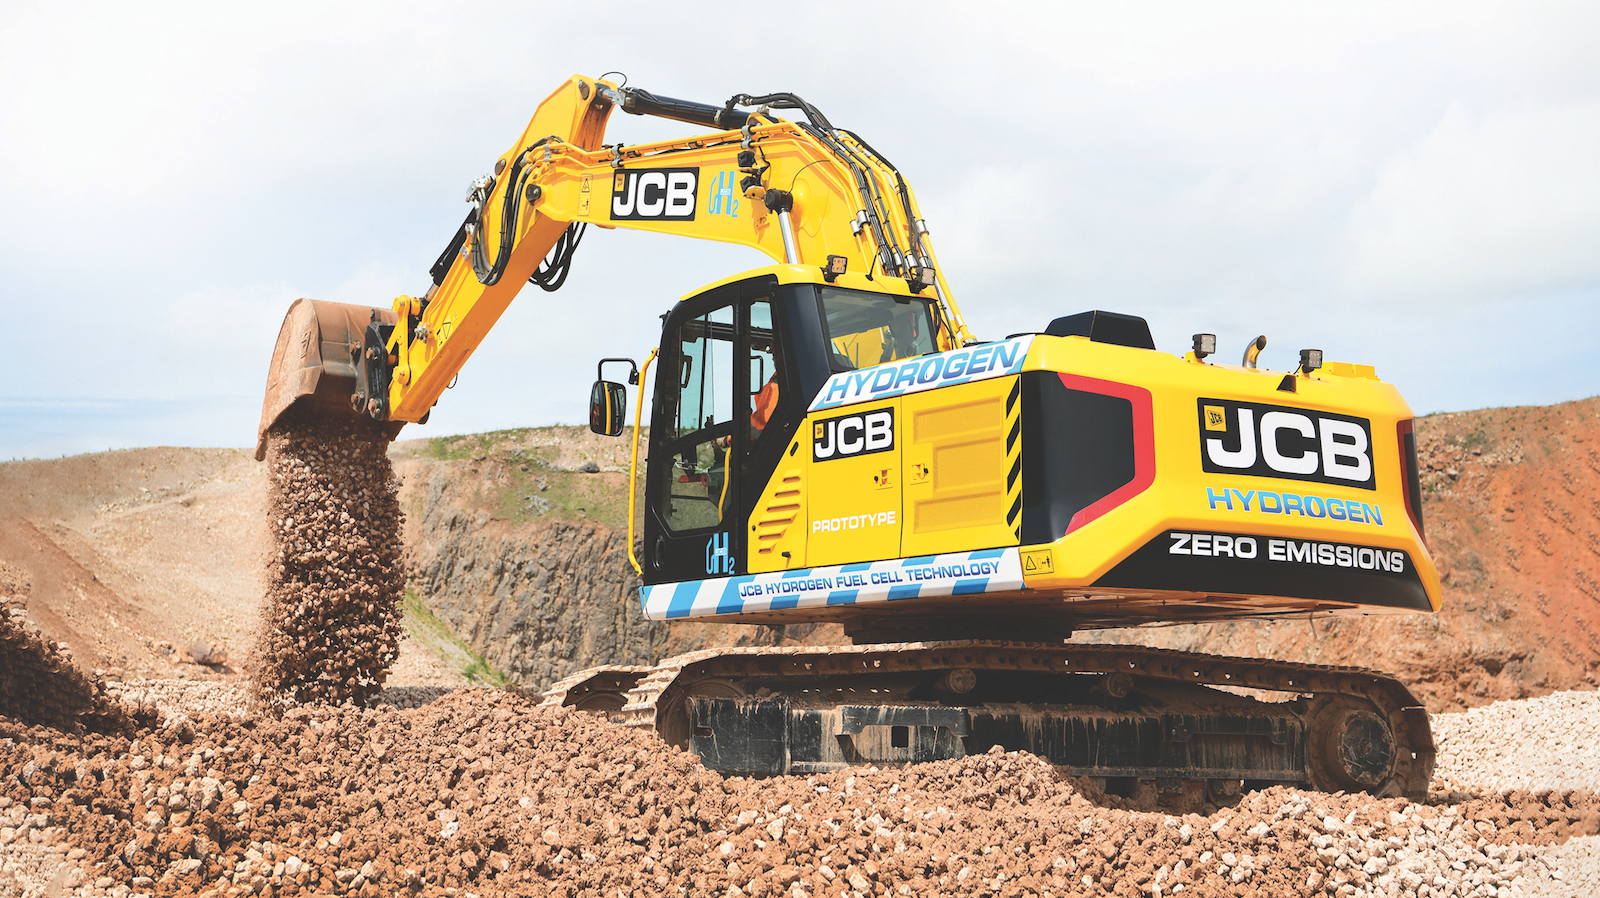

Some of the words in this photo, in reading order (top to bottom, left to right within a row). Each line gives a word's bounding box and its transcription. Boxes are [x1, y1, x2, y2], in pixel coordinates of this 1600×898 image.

[613, 172, 696, 216] JCB
[826, 342, 1020, 401] HYDROGEN
[815, 411, 893, 458] JCB
[1210, 411, 1223, 424] JCB
[1206, 407, 1372, 482] JCB
[812, 511, 896, 533] PROTOTYPE
[1206, 487, 1384, 526] HYDROGEN
[1169, 532, 1258, 559] ZERO
[1268, 539, 1404, 573] EMISSIONS
[740, 584, 763, 597] JCB
[765, 577, 833, 595] HYDROGEN
[836, 574, 868, 588] FUEL
[872, 570, 903, 584] CELL
[906, 561, 1000, 581] TECHNOLOGY
